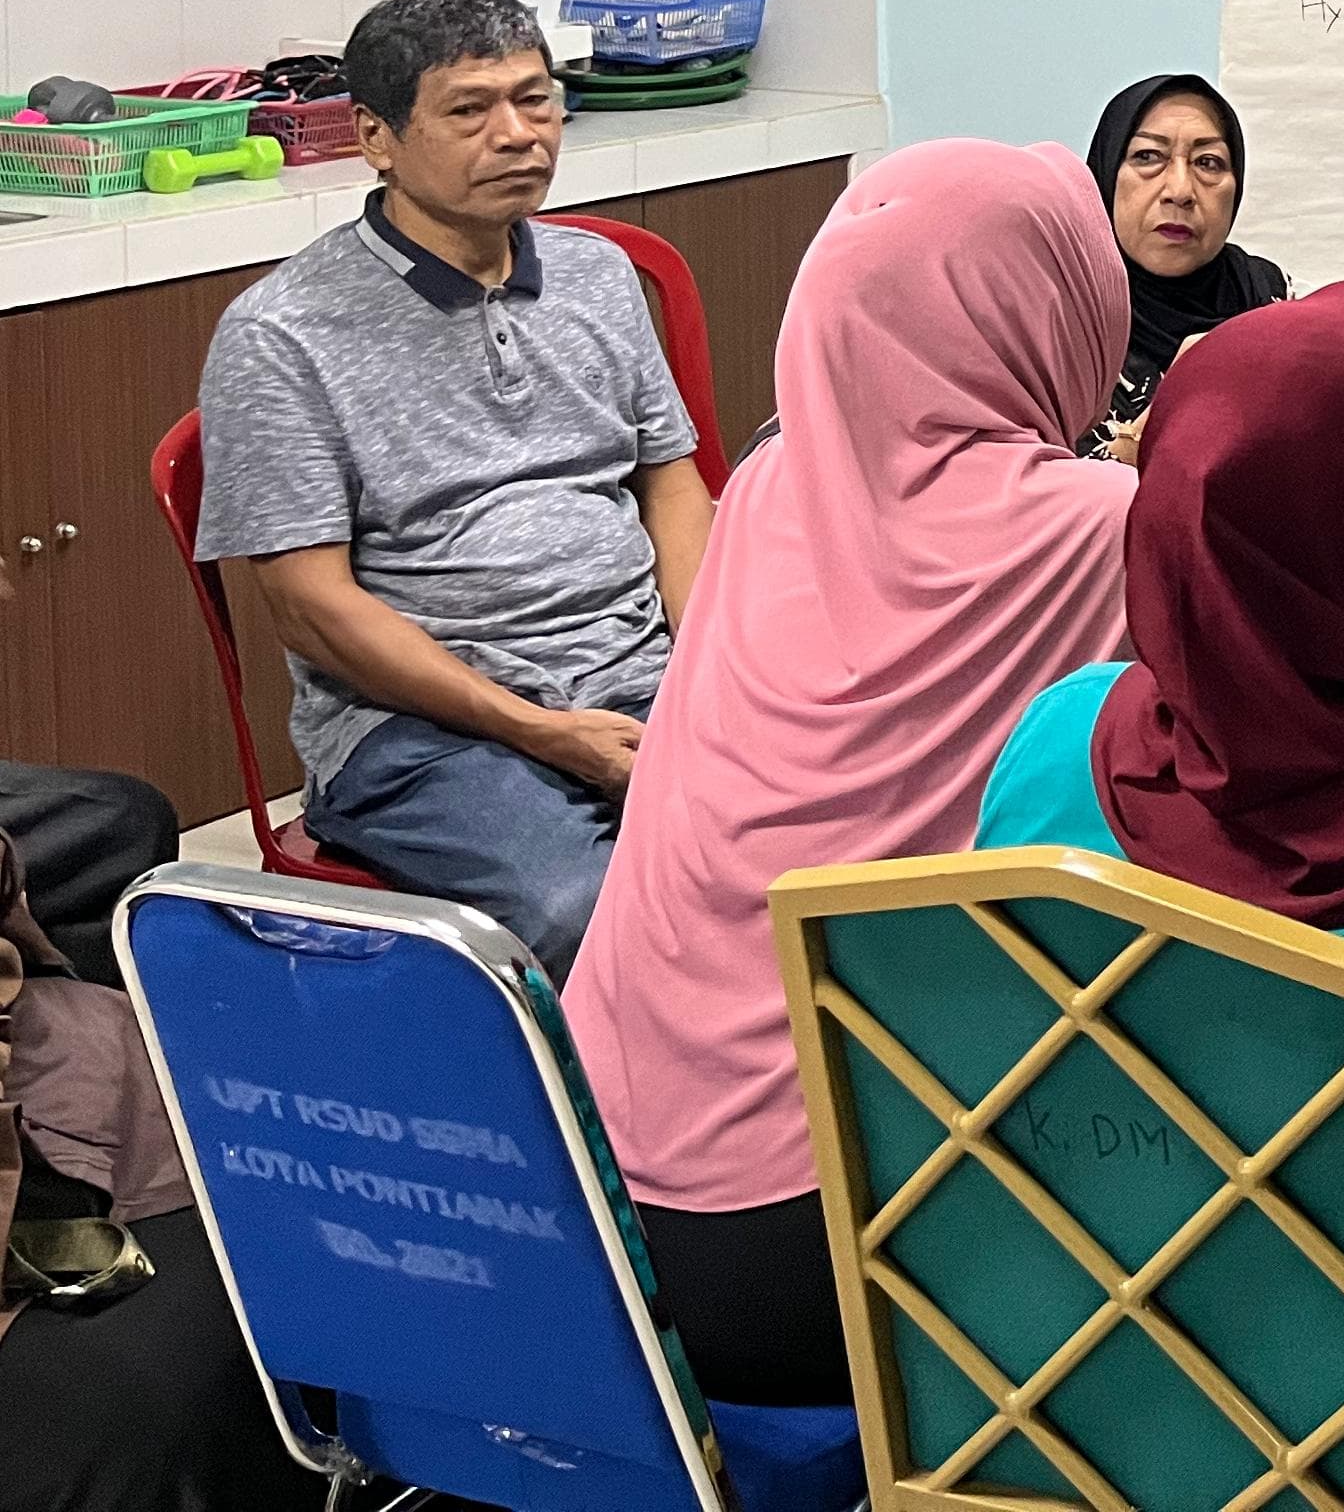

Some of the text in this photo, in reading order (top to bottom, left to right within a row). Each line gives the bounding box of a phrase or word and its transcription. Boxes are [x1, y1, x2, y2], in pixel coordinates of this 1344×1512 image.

[202, 1073, 285, 1120] UPT
[293, 1093, 404, 1143] RSUD
[1091, 1113, 1171, 1166] DM
